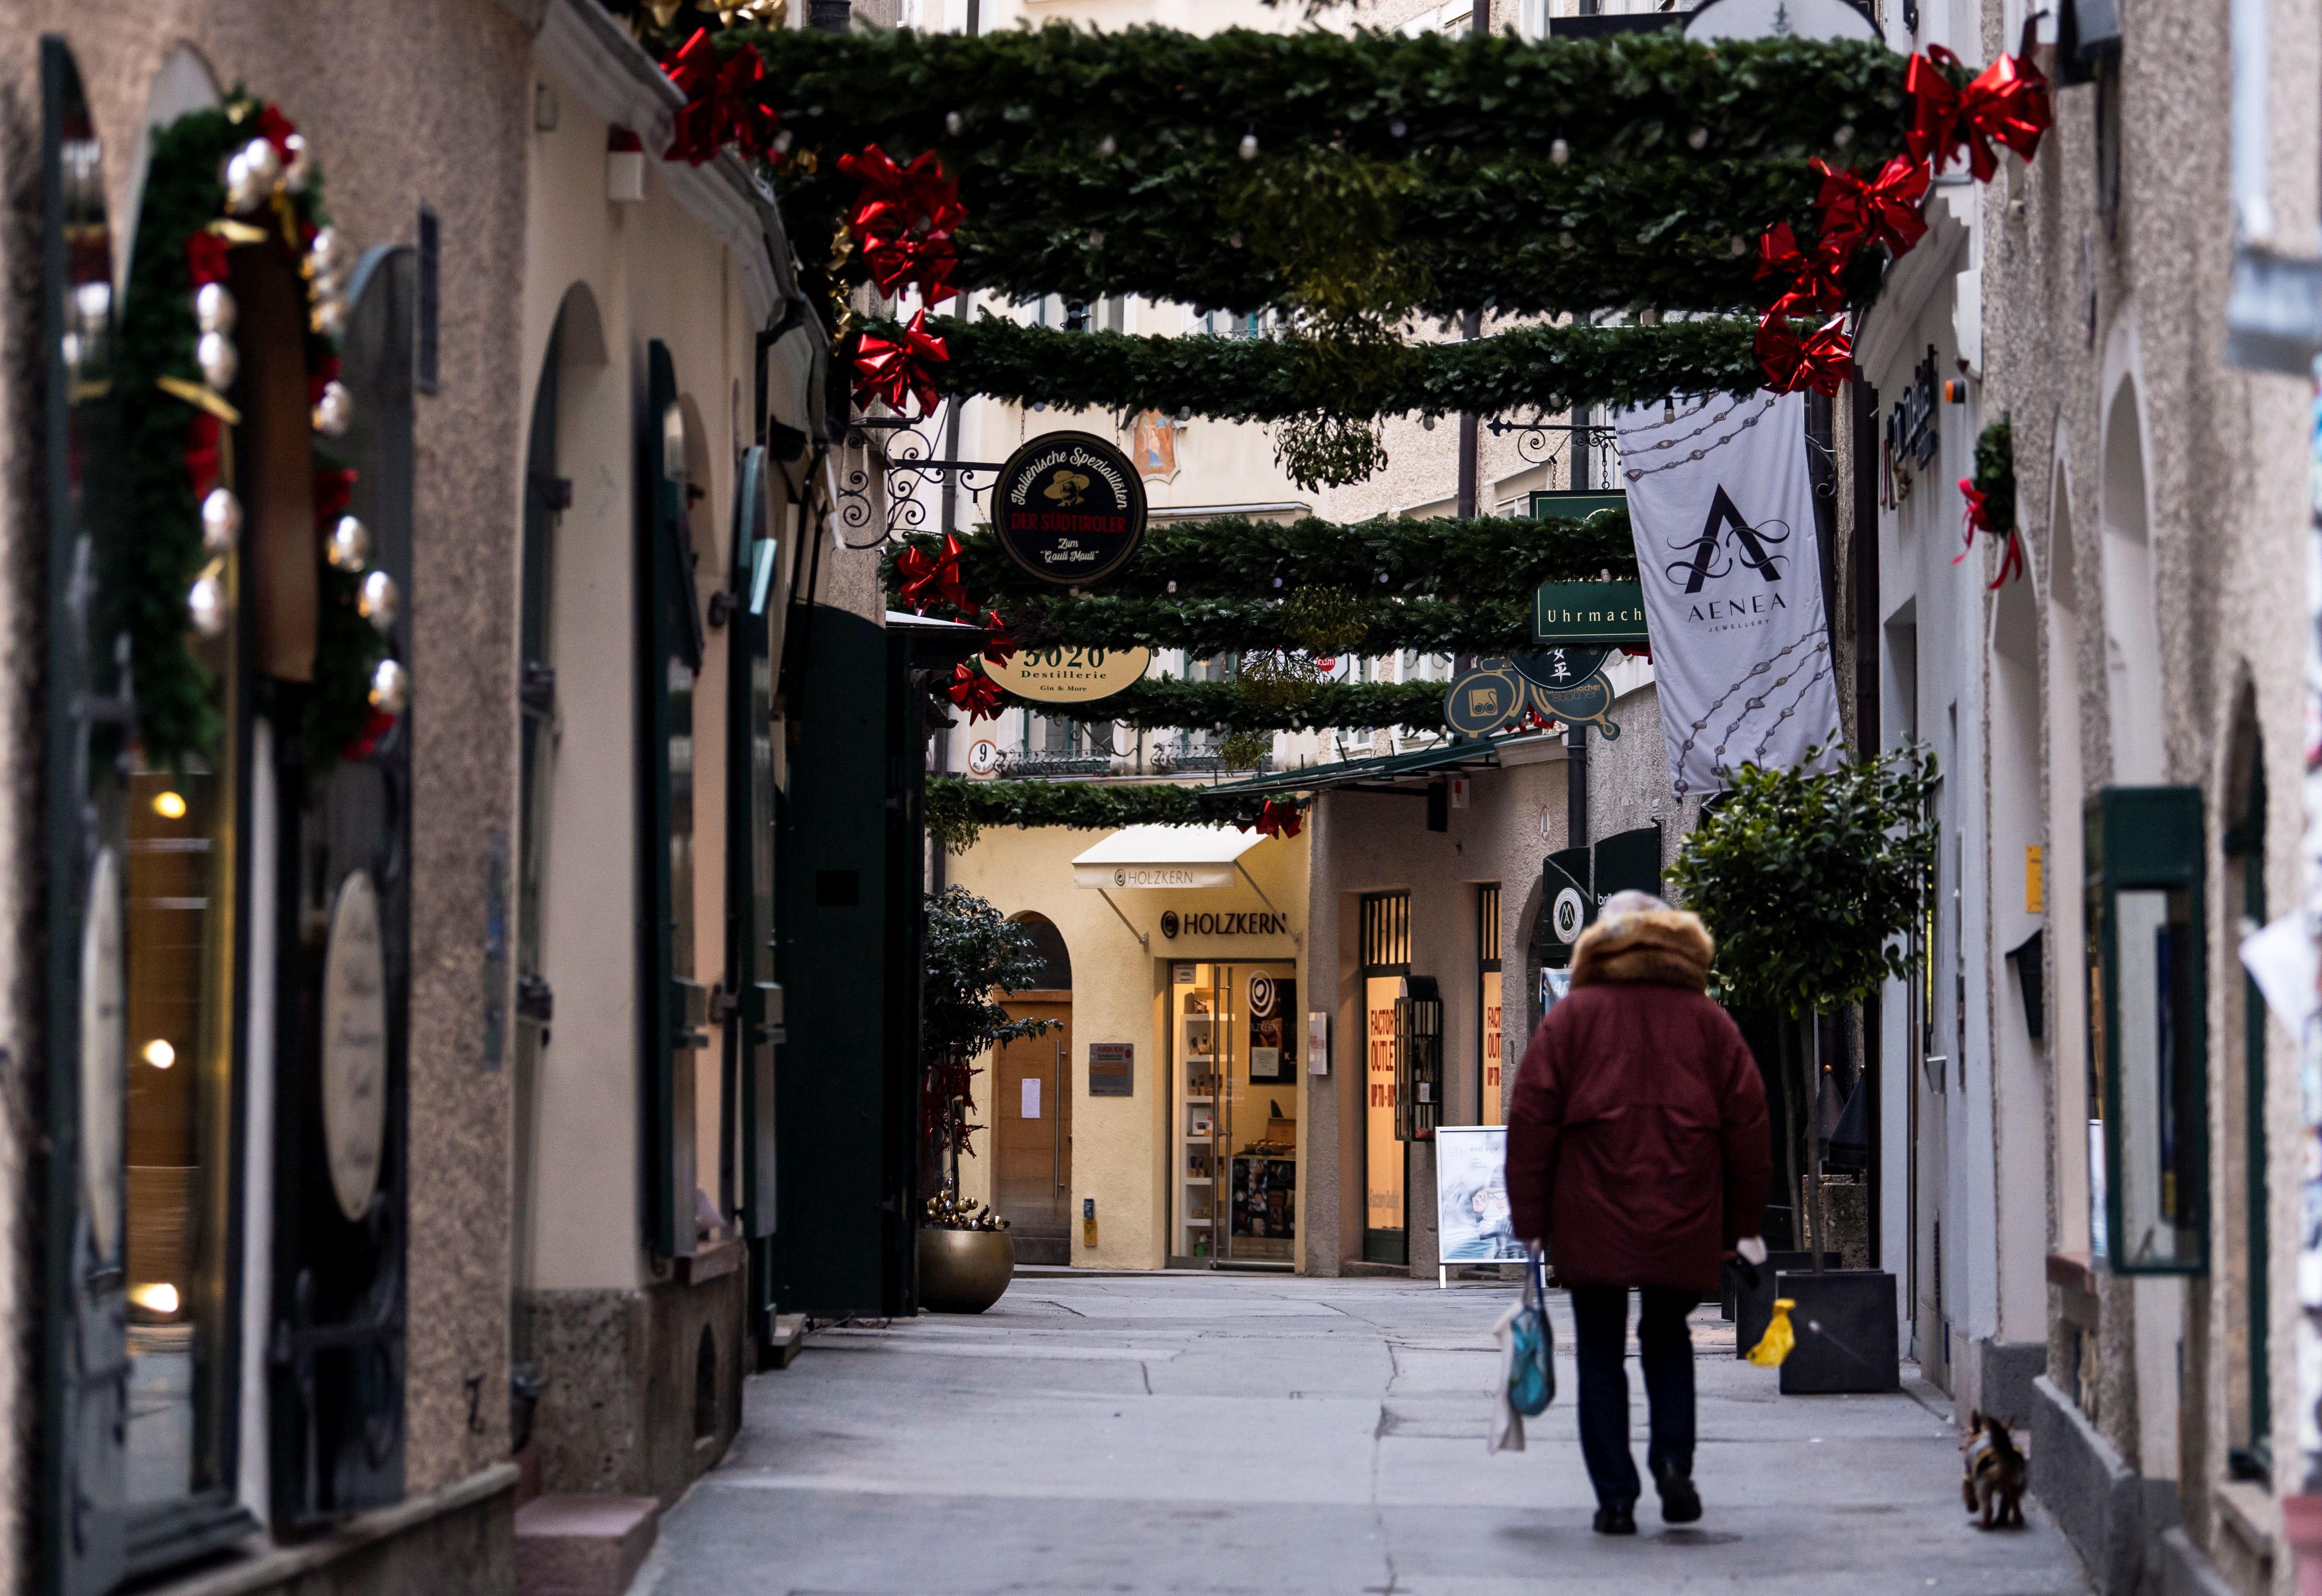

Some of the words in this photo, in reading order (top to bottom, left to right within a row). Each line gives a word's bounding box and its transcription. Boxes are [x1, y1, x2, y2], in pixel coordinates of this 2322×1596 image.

[1011, 450, 1067, 505] Italienische
[1070, 447, 1127, 510] Spezialitäten
[1011, 512, 1038, 530] DER
[1041, 511, 1126, 533] SÜDTIROLER
[1058, 538, 1079, 549] Zum
[1548, 608, 1642, 622] Uhrmach
[1688, 592, 1786, 622] AENEA
[1708, 619, 1770, 633] JEWELLERY
[1021, 670, 1106, 679] Destillerie
[980, 743, 987, 762] 9
[1128, 871, 1193, 884] HOLZKERN
[1184, 913, 1286, 935] HOLZKERN
